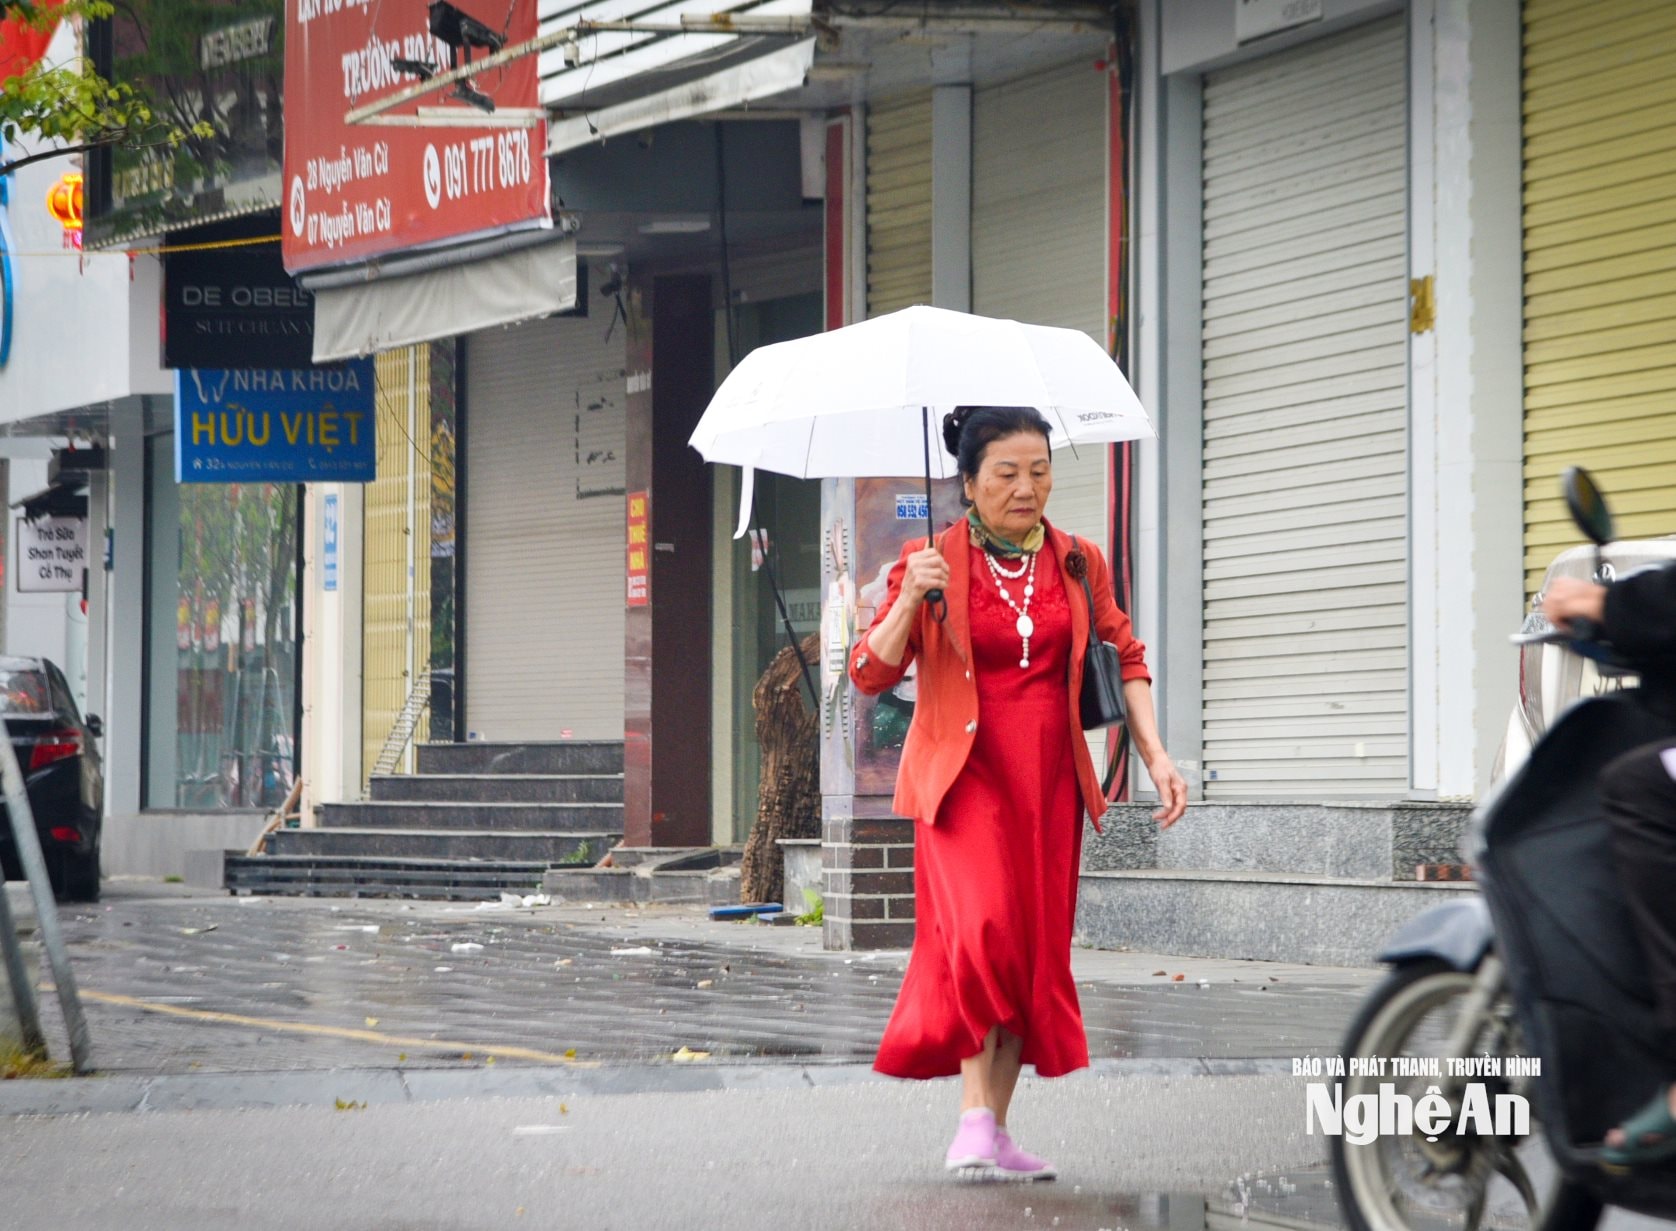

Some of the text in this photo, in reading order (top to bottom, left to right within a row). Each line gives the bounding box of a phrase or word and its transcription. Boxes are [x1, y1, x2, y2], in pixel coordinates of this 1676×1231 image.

[307, 159, 318, 191] 28
[319, 145, 353, 194] Nguyễn
[354, 145, 373, 179] Văn
[445, 128, 531, 201] 091 777 8678
[307, 213, 318, 246] 07
[319, 201, 355, 248] Nguyễn
[356, 202, 374, 234] Văn
[182, 286, 222, 306] DE
[191, 402, 363, 453] HỮU VIỆT
[28, 544, 84, 563] Shan Tuyết
[37, 526, 76, 541] Trà Sữa
